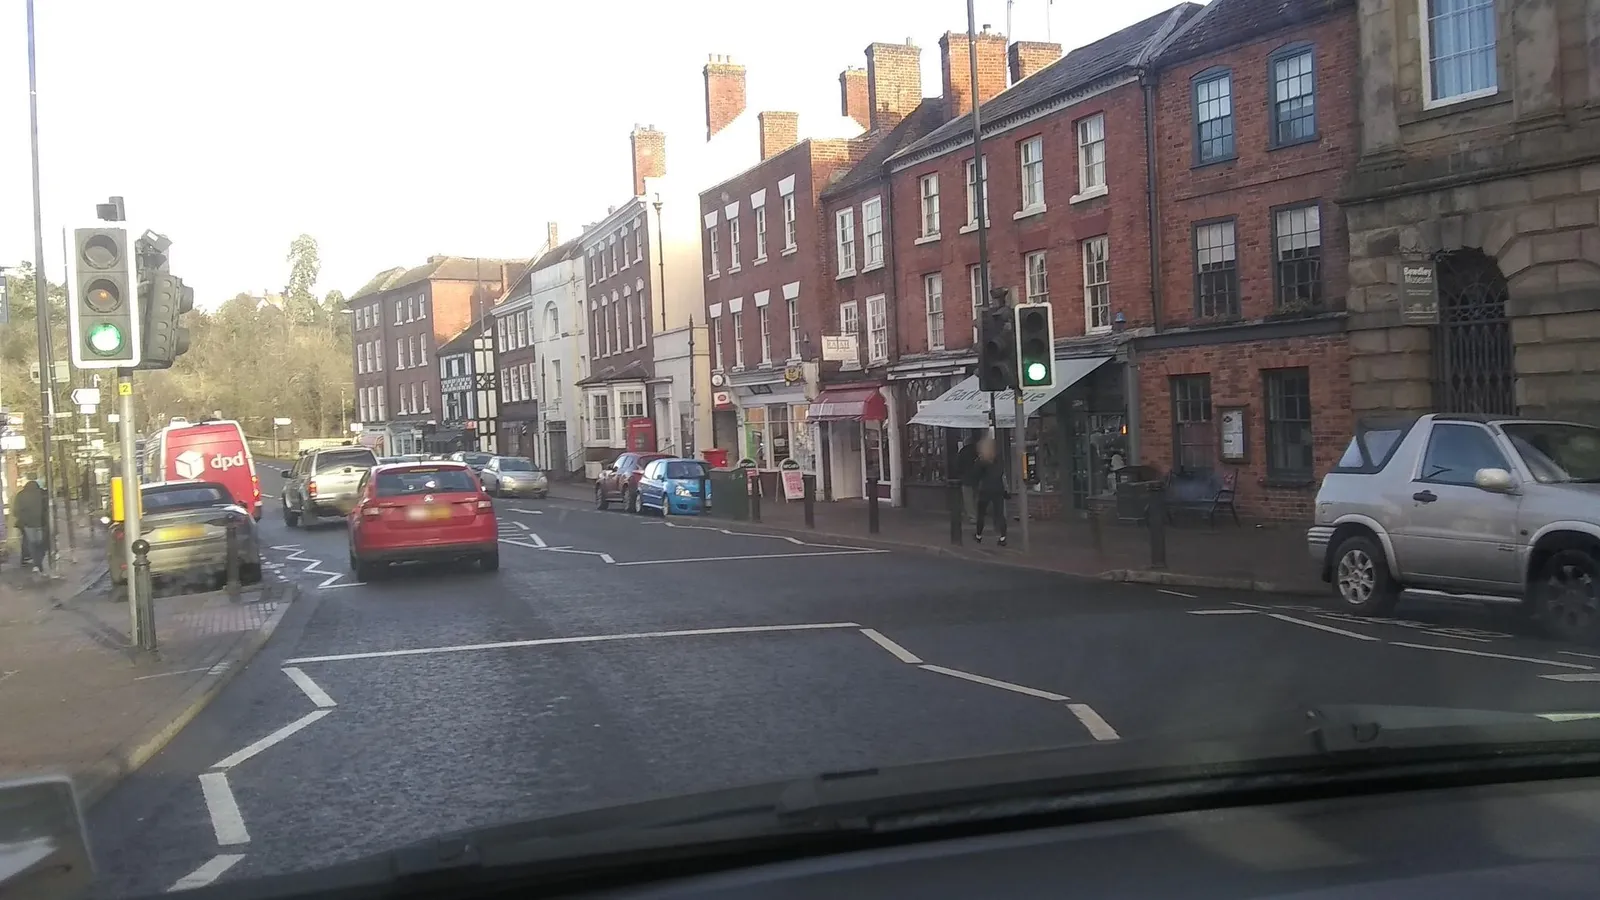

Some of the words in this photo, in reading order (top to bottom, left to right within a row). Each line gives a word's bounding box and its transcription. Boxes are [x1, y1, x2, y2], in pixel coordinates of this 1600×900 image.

[1404, 275, 1433, 284] Museum
[122, 384, 129, 393] 2
[210, 451, 245, 471] dpd
